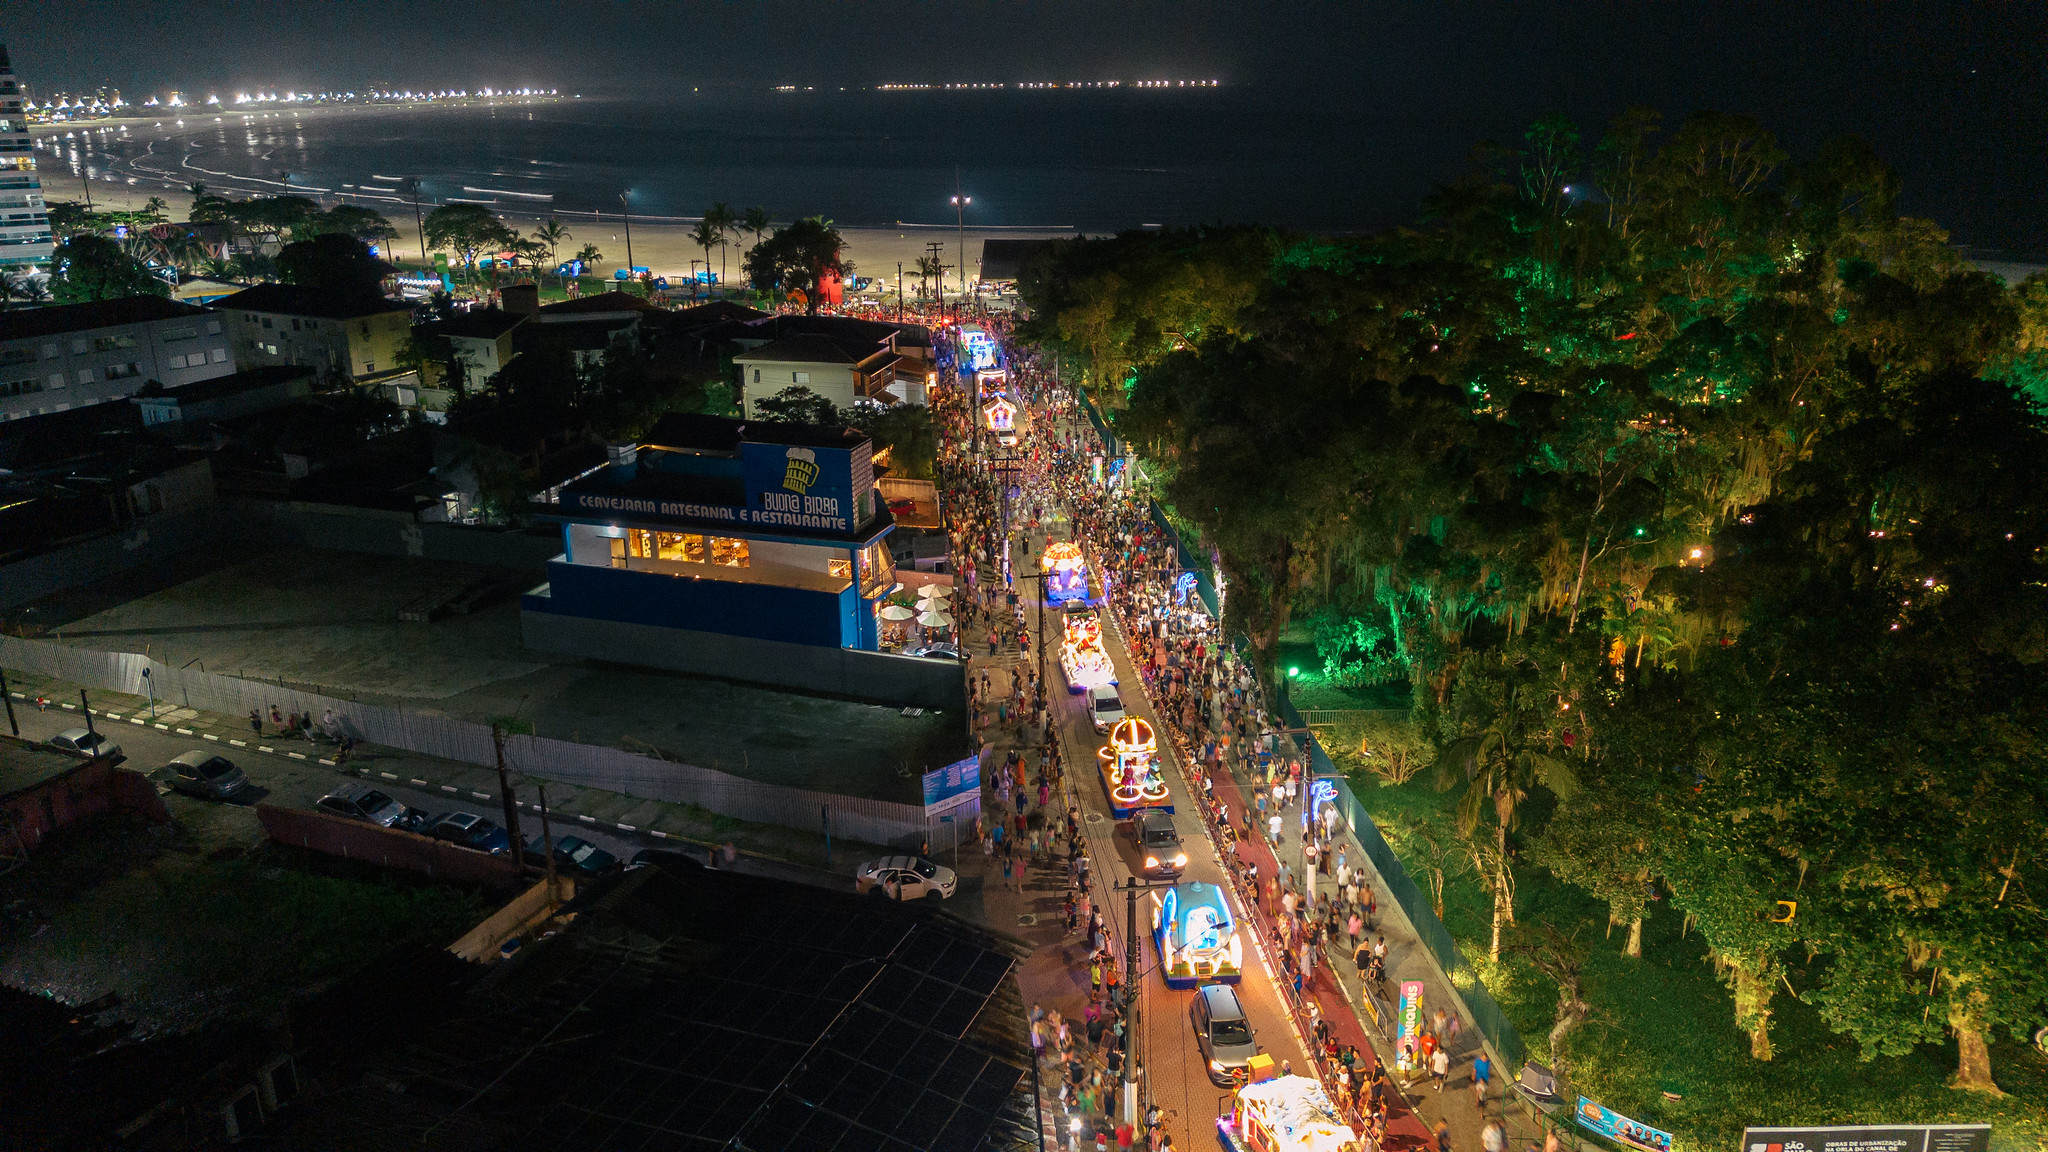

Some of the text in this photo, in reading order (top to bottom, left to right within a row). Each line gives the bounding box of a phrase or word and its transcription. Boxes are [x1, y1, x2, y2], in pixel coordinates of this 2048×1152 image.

[579, 495, 846, 530] CERVEJARIA ARTESANAL E RESTAURANTE
[1784, 1140, 1805, 1150] SÃO
[1859, 1139, 1907, 1147] URBANIZAÇÃO
